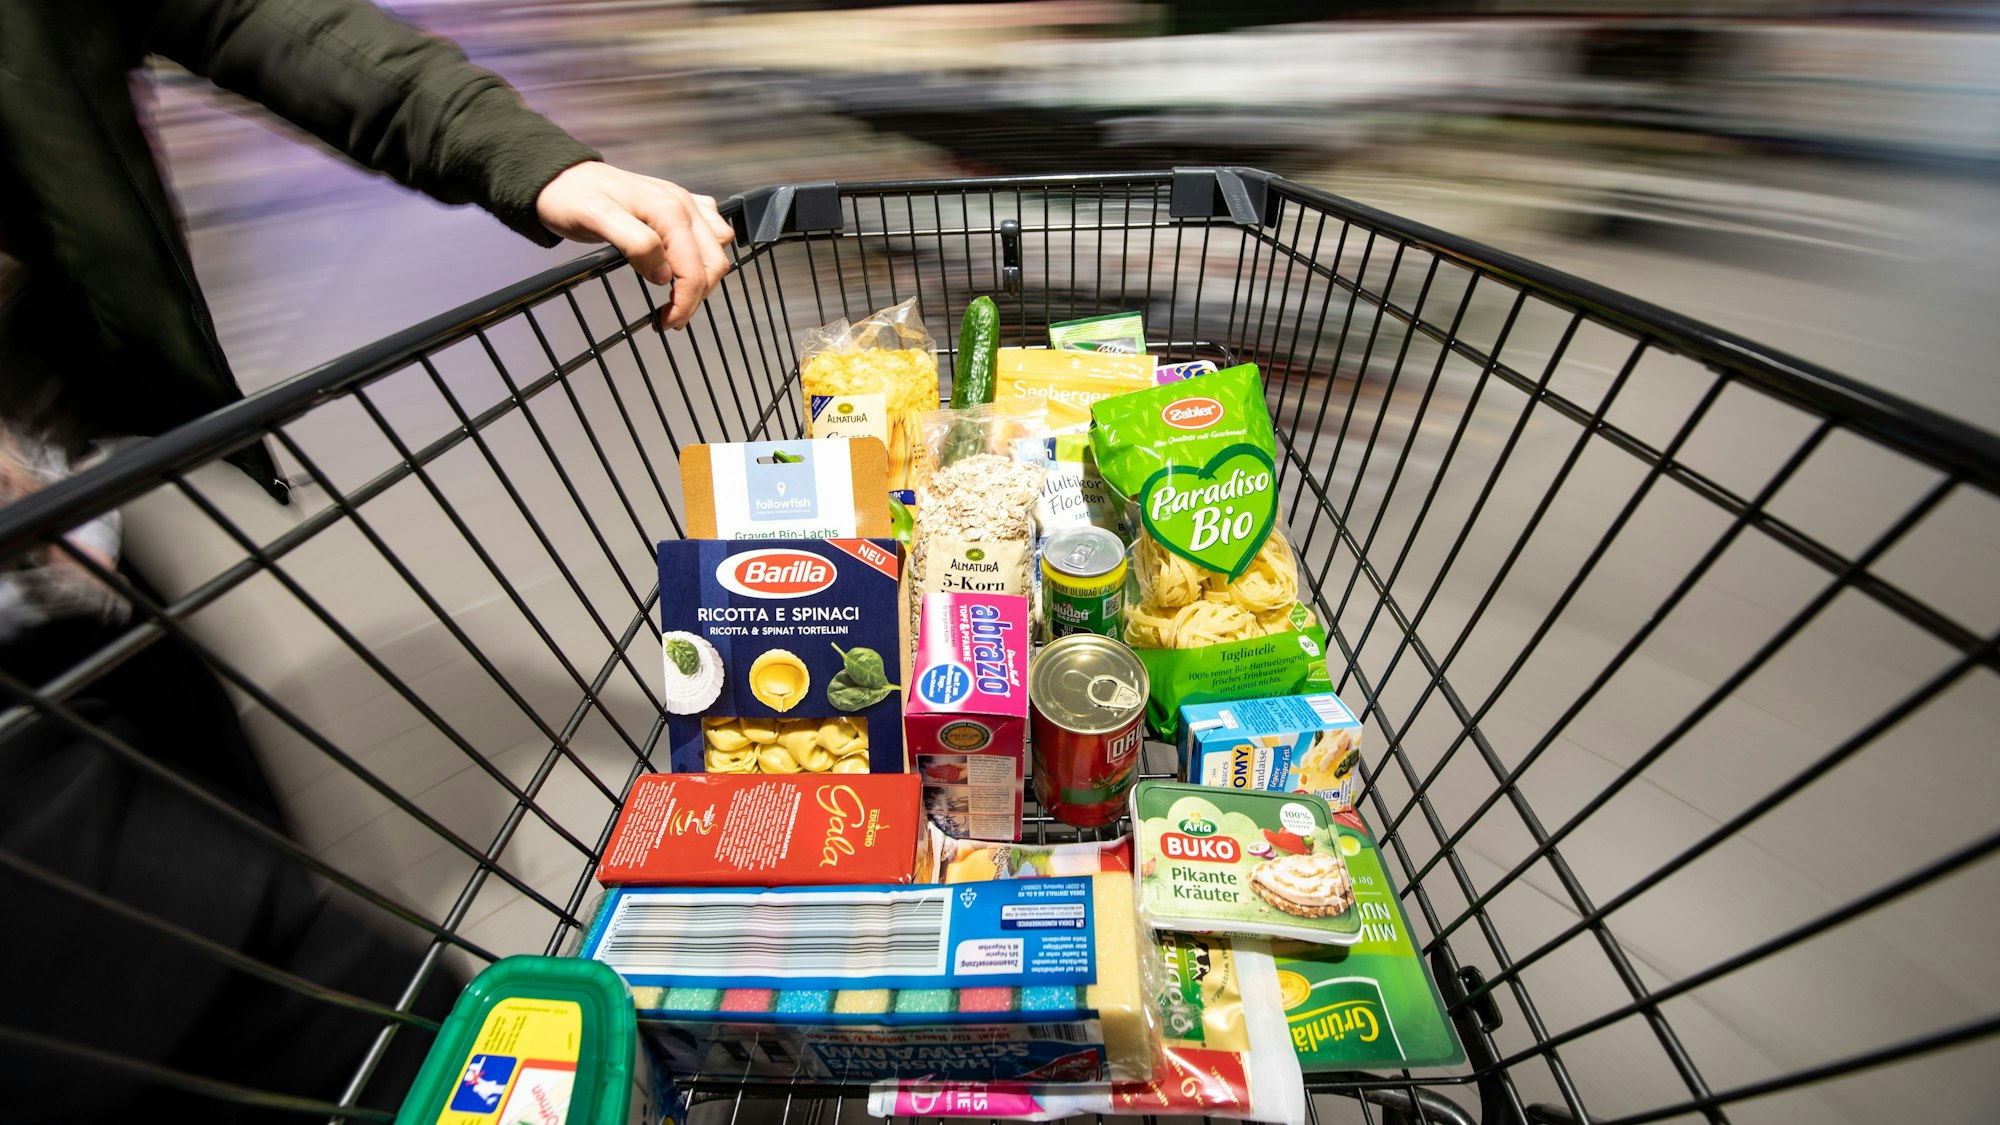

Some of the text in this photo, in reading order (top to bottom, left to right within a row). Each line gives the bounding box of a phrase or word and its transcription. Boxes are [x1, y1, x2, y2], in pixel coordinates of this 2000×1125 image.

[1013, 380, 1111, 402] Seeberger
[1169, 405, 1216, 421] Zabler
[1210, 427, 1247, 439] Geschmack
[1040, 475, 1102, 497] Multikor
[1151, 468, 1269, 521] Paradiso
[755, 498, 811, 510] followfish
[1048, 490, 1105, 515] Flocken
[779, 528, 839, 540] Bio-Lachs
[1189, 506, 1253, 552] Bio
[857, 543, 887, 566] NEU
[744, 560, 827, 584] Barilla
[943, 573, 1005, 591] 5-Korn
[697, 606, 860, 622] RICOTTA E SPINACI
[709, 625, 849, 636] RICOTTA & SPINAT TORTELLINI
[969, 604, 1012, 696] abrazo
[1220, 643, 1276, 663] Tagliatelle
[1188, 671, 1209, 681] 100%
[1210, 668, 1232, 678] reiner
[1211, 667, 1288, 688] frisches Trinkwasser
[1220, 677, 1282, 693] und sonst nichts.
[1233, 749, 1249, 789] OMY
[1254, 750, 1267, 791] landaise
[1284, 811, 1311, 820] 100%
[816, 784, 865, 867] Gala
[864, 809, 878, 848] EDUSCHO
[1183, 820, 1212, 834] Arla
[1167, 837, 1234, 860] BUKO
[1172, 867, 1237, 885] Pikante
[1360, 875, 1374, 886] Der
[1173, 884, 1240, 903] Kräuter
[1362, 924, 1398, 943] MIL
[960, 959, 1019, 967] Zusammensetzung:
[1291, 1006, 1380, 1053] Grünlä
[818, 1043, 1031, 1059] SCHWAMM
[828, 1058, 992, 1071] HAUSHALTS
[1179, 1076, 1201, 1097] 6
